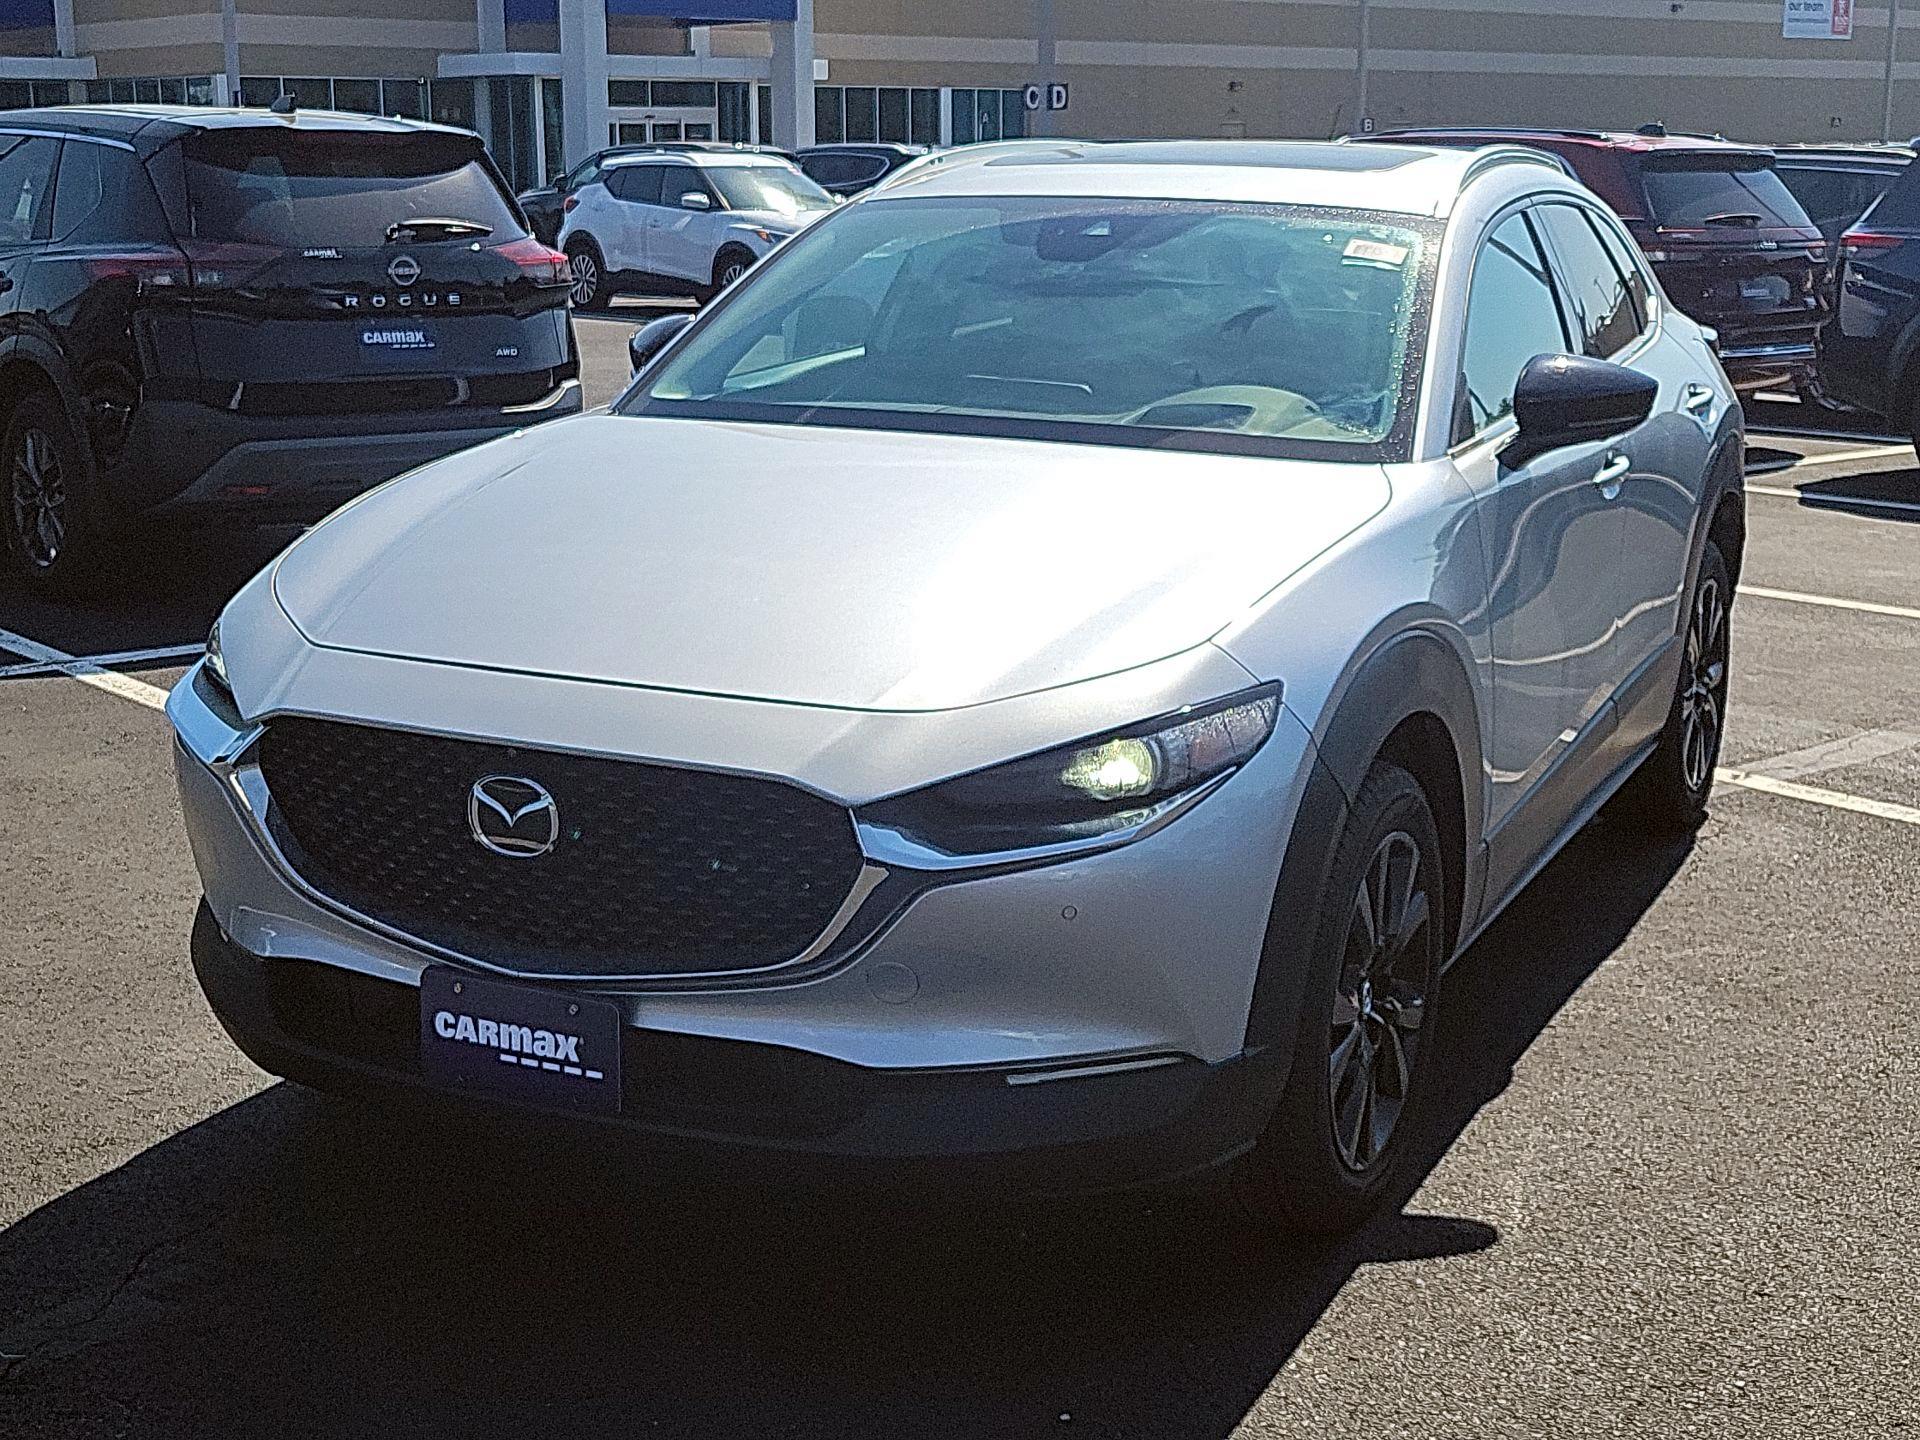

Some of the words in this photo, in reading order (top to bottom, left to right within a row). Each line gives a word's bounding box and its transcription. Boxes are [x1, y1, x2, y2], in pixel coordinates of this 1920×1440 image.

[1026, 85, 1040, 109] C
[1053, 86, 1067, 109] D
[1364, 119, 1373, 131] B
[345, 293, 461, 307] ROGUE
[496, 348, 518, 357] AWD
